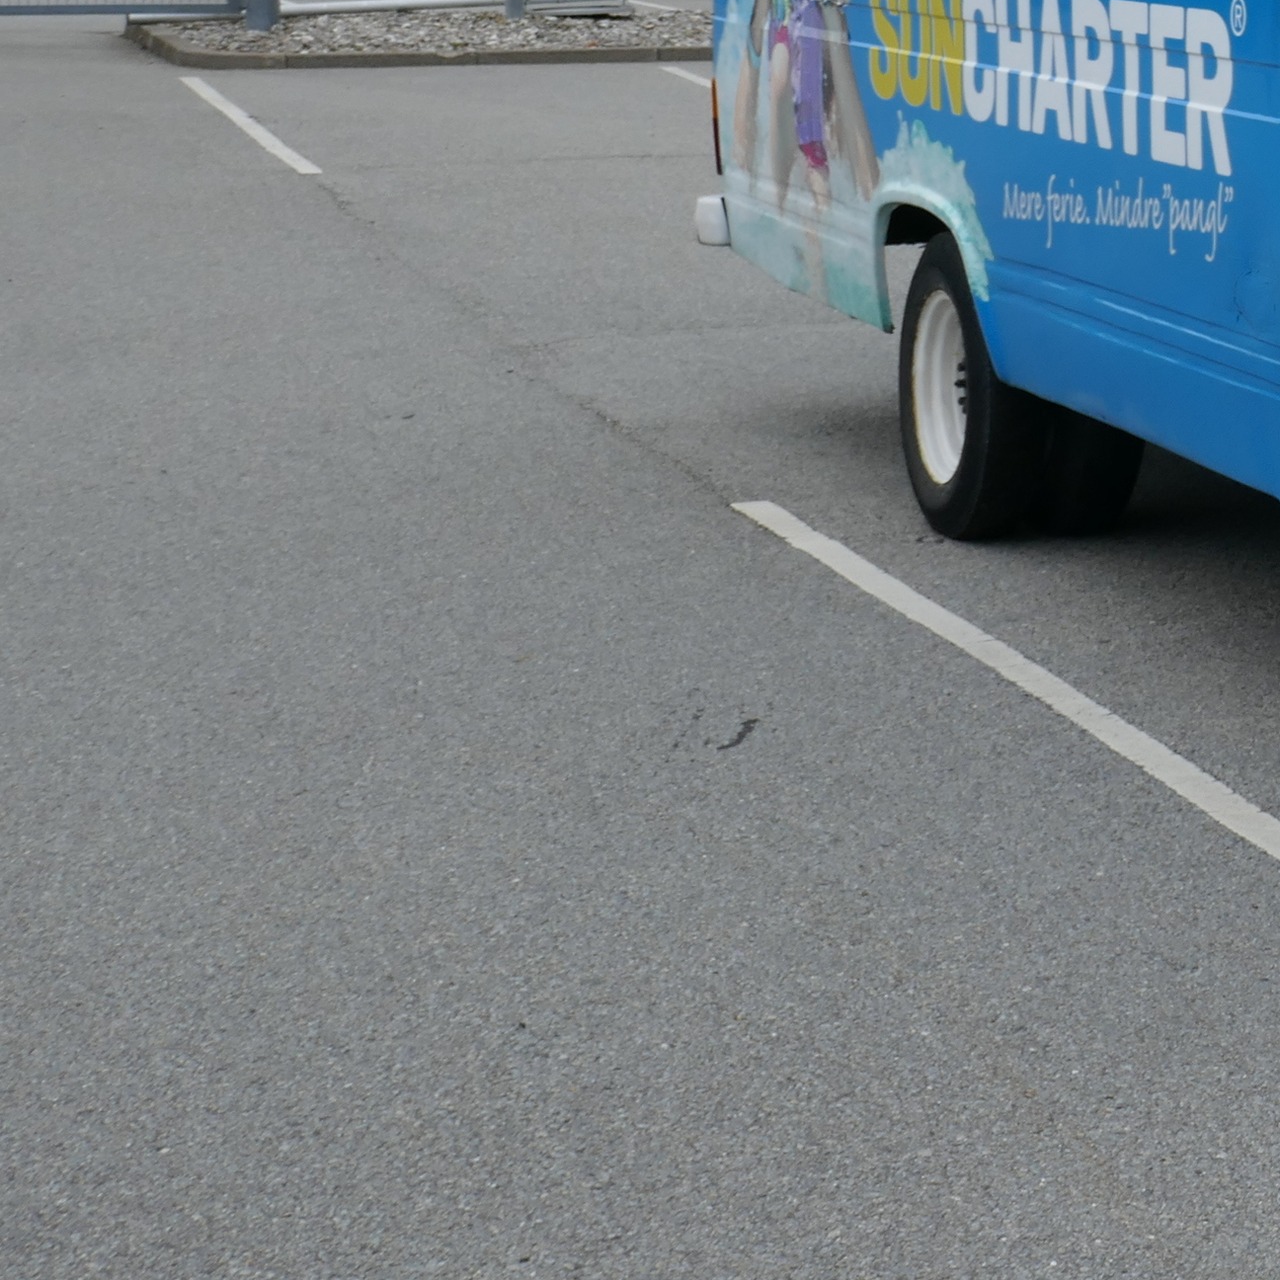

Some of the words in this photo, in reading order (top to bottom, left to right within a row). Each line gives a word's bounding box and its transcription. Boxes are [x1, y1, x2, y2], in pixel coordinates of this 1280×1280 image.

[1003, 181, 1045, 221] Mere
[1045, 174, 1090, 249] ferie.
[1095, 176, 1164, 230] Mindre
